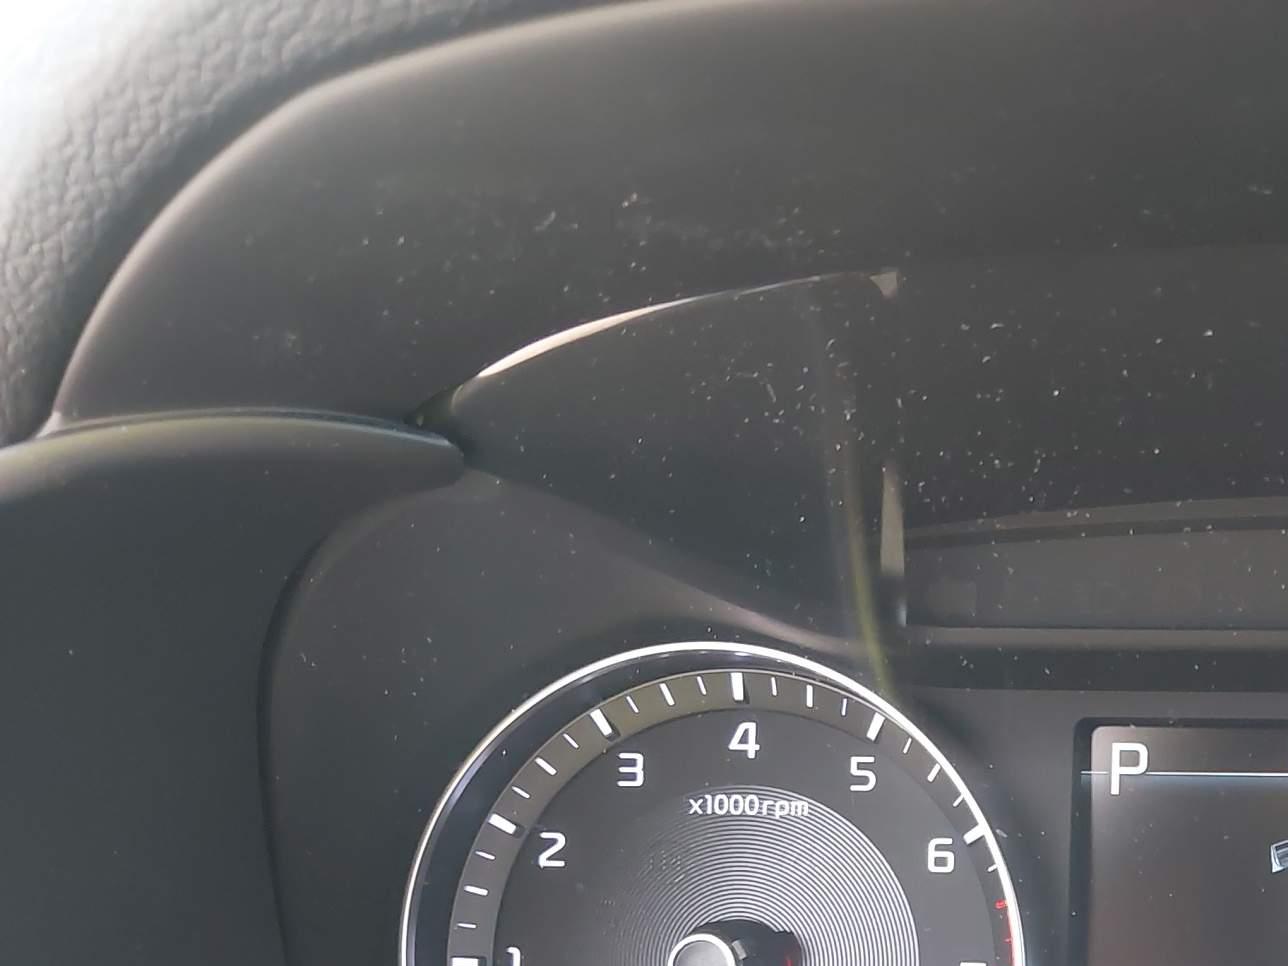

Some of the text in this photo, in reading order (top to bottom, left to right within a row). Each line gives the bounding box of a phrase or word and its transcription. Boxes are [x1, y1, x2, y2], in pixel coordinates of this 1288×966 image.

[728, 722, 760, 758] 4
[616, 752, 645, 787] 3
[848, 756, 877, 792] 5
[1109, 742, 1149, 795] P
[538, 832, 566, 867] 2
[926, 838, 956, 874] 6
